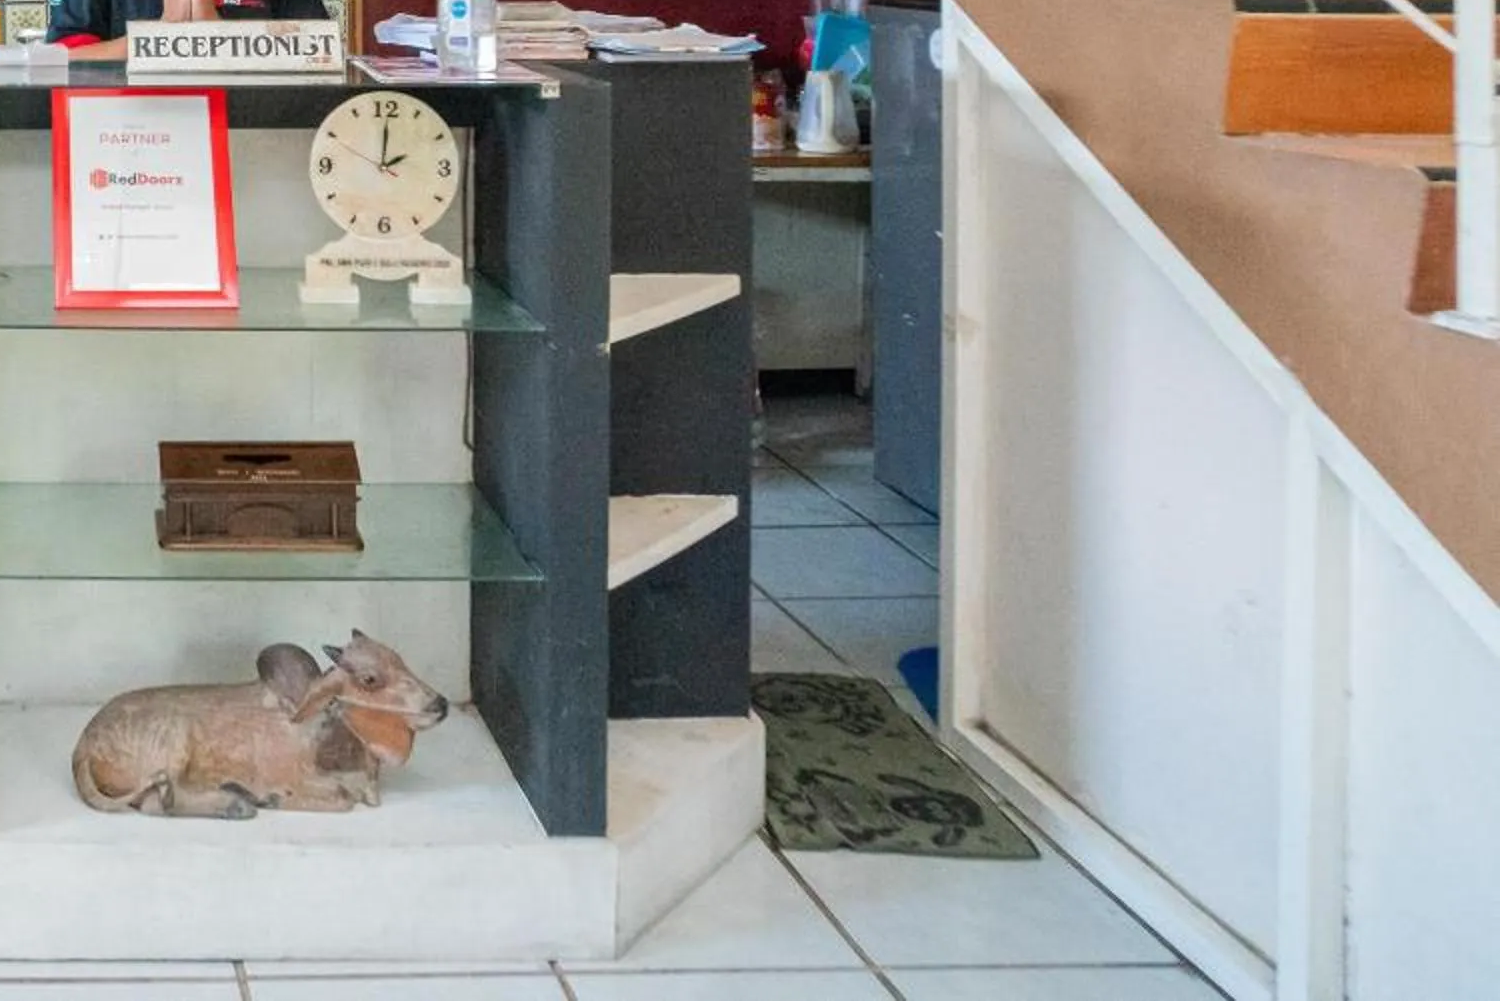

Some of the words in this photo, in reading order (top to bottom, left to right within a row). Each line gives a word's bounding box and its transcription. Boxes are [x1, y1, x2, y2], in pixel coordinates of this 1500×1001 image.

[133, 34, 335, 59] RECEPTIONIST
[373, 100, 399, 118] 12
[99, 132, 171, 145] PARTNER
[319, 157, 333, 174] 9
[438, 159, 451, 177] 3
[377, 216, 392, 234] 6
